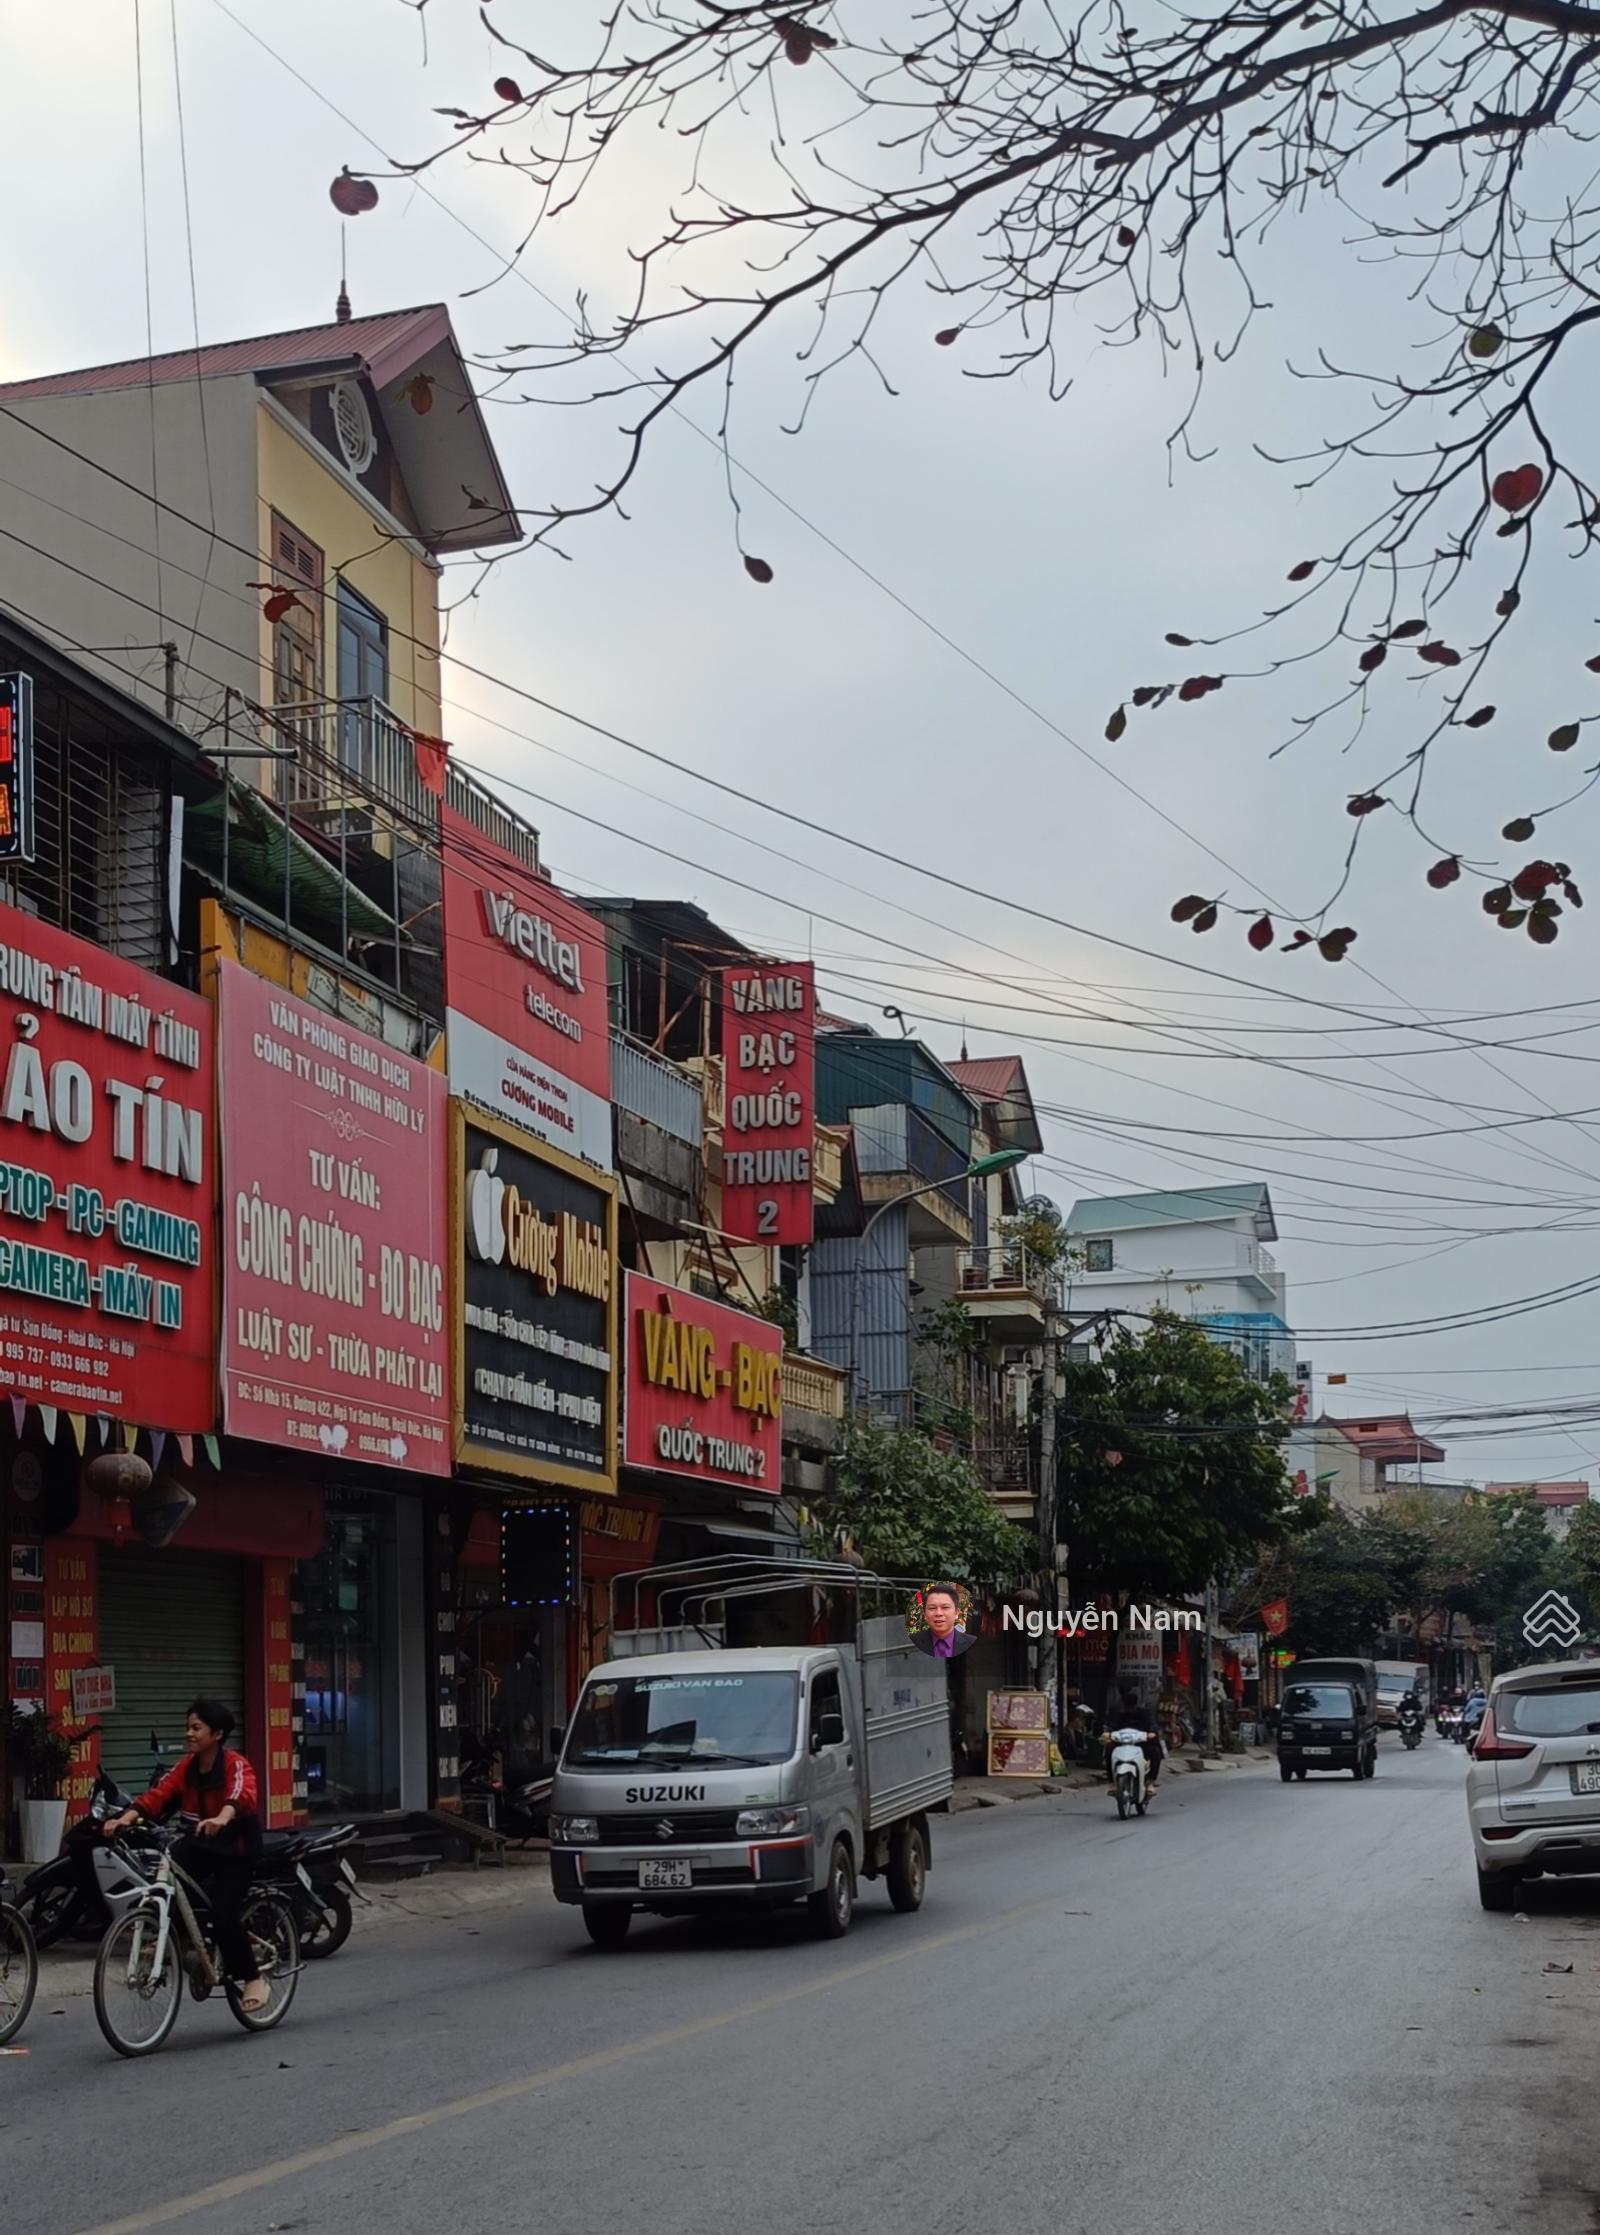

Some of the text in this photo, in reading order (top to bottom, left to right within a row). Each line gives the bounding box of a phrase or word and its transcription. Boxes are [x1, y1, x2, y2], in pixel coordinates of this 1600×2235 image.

[57, 966, 102, 1030] TÂM
[105, 993, 151, 1048] MÁY
[155, 1009, 199, 1070] TÍNH
[525, 983, 582, 1043] telecom
[731, 971, 803, 1013] VÀNG
[270, 1001, 410, 1090] VĂN PHÒNG GIAO DỊCH
[739, 1030, 796, 1074] BẠC
[253, 1032, 292, 1074] CÔNG
[295, 1053, 312, 1081] TY
[315, 1063, 345, 1101] LUẬT
[349, 1079, 381, 1115] TNHH
[410, 1109, 425, 1134] LÝ
[731, 1081, 802, 1132] QUỐC
[106, 1075, 202, 1185] TÍN
[538, 1099, 575, 1133] MOBILE
[309, 1149, 382, 1210] TƯ VẤN:
[723, 1147, 811, 1186] TRUNG
[67, 1184, 104, 1237] PC
[115, 1199, 200, 1266] GAMING
[757, 1200, 778, 1235] 2
[235, 1181, 293, 1286] CÔNG
[298, 1210, 364, 1308] CHỨNG
[380, 1245, 404, 1320] ĐO
[408, 1255, 443, 1344] ĐẠC
[560, 1211, 610, 1303] Mobile
[99, 1262, 153, 1321] MÁY
[153, 1280, 182, 1330] IN
[237, 1307, 283, 1361] LUẬT
[288, 1322, 313, 1363] SƯ
[328, 1332, 371, 1378] THỪA
[375, 1347, 415, 1389] PHÁT
[419, 1363, 442, 1402] LẠI
[638, 1293, 716, 1400] VÀNG
[733, 1341, 782, 1431] BẠC
[657, 1416, 767, 1478] QUỐC TRUNG 2
[625, 1785, 705, 1803] SUZUKI
[654, 1861, 676, 1873] 29H
